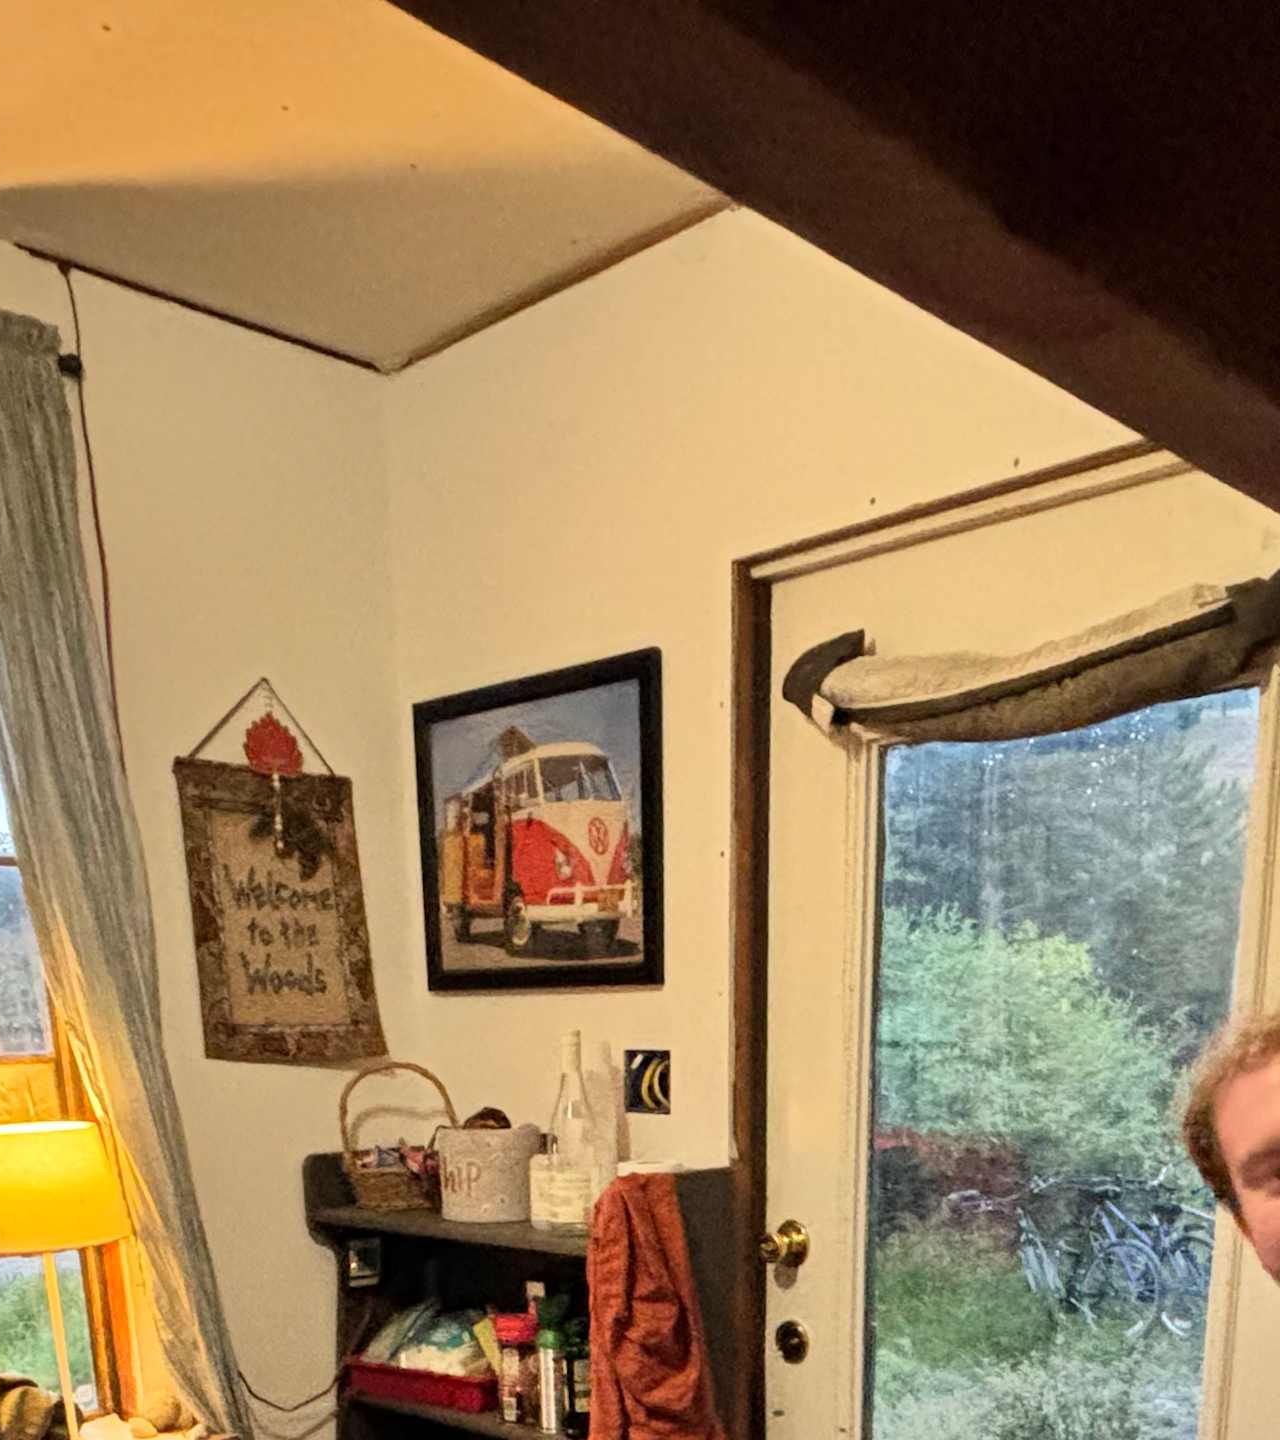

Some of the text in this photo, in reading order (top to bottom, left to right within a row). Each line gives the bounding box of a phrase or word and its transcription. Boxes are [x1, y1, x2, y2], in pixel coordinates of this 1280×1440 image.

[223, 864, 334, 911] Welcome
[247, 917, 320, 949] to the
[239, 951, 328, 996] Woods
